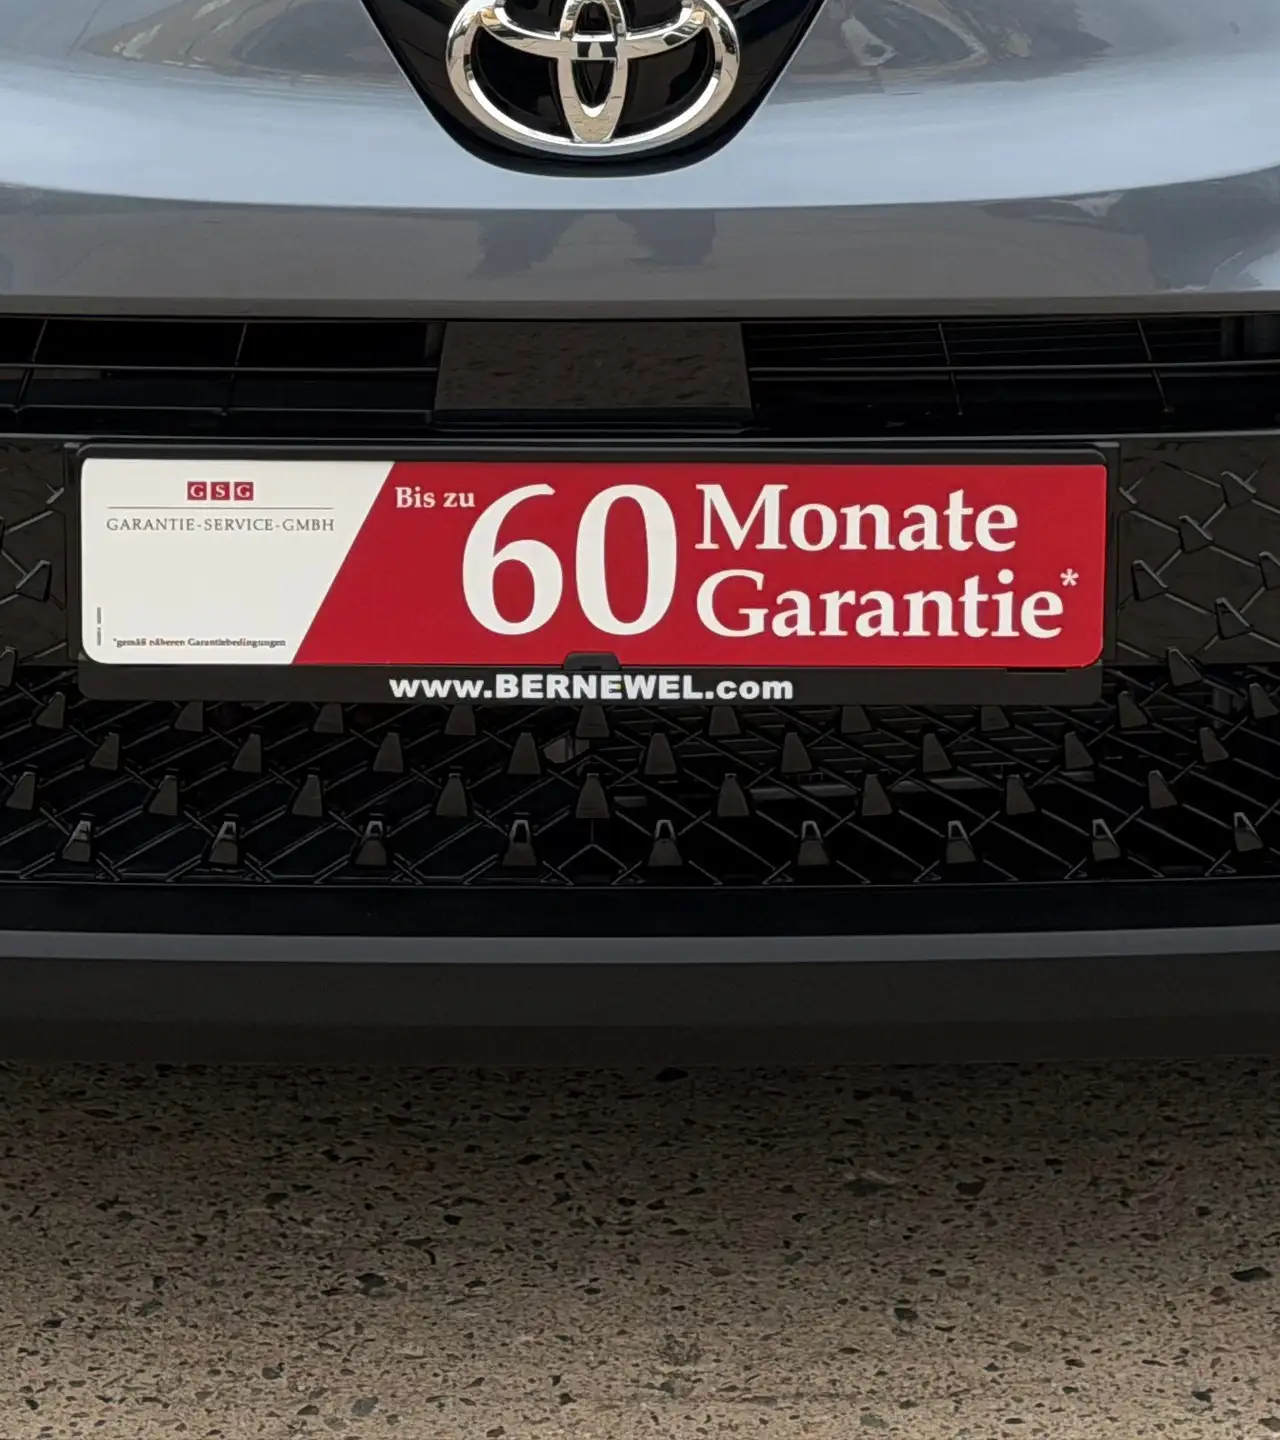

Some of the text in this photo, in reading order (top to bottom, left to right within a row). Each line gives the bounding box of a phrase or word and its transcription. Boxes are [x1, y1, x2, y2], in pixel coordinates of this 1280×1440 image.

[189, 482, 253, 500] GSG
[395, 486, 476, 509] Bis zu
[106, 517, 335, 532] GARANTIE-SERVICE-GMBH
[694, 482, 1018, 552] Monate
[462, 482, 678, 636] 60
[389, 674, 794, 701] www.BERNEWEL.com
